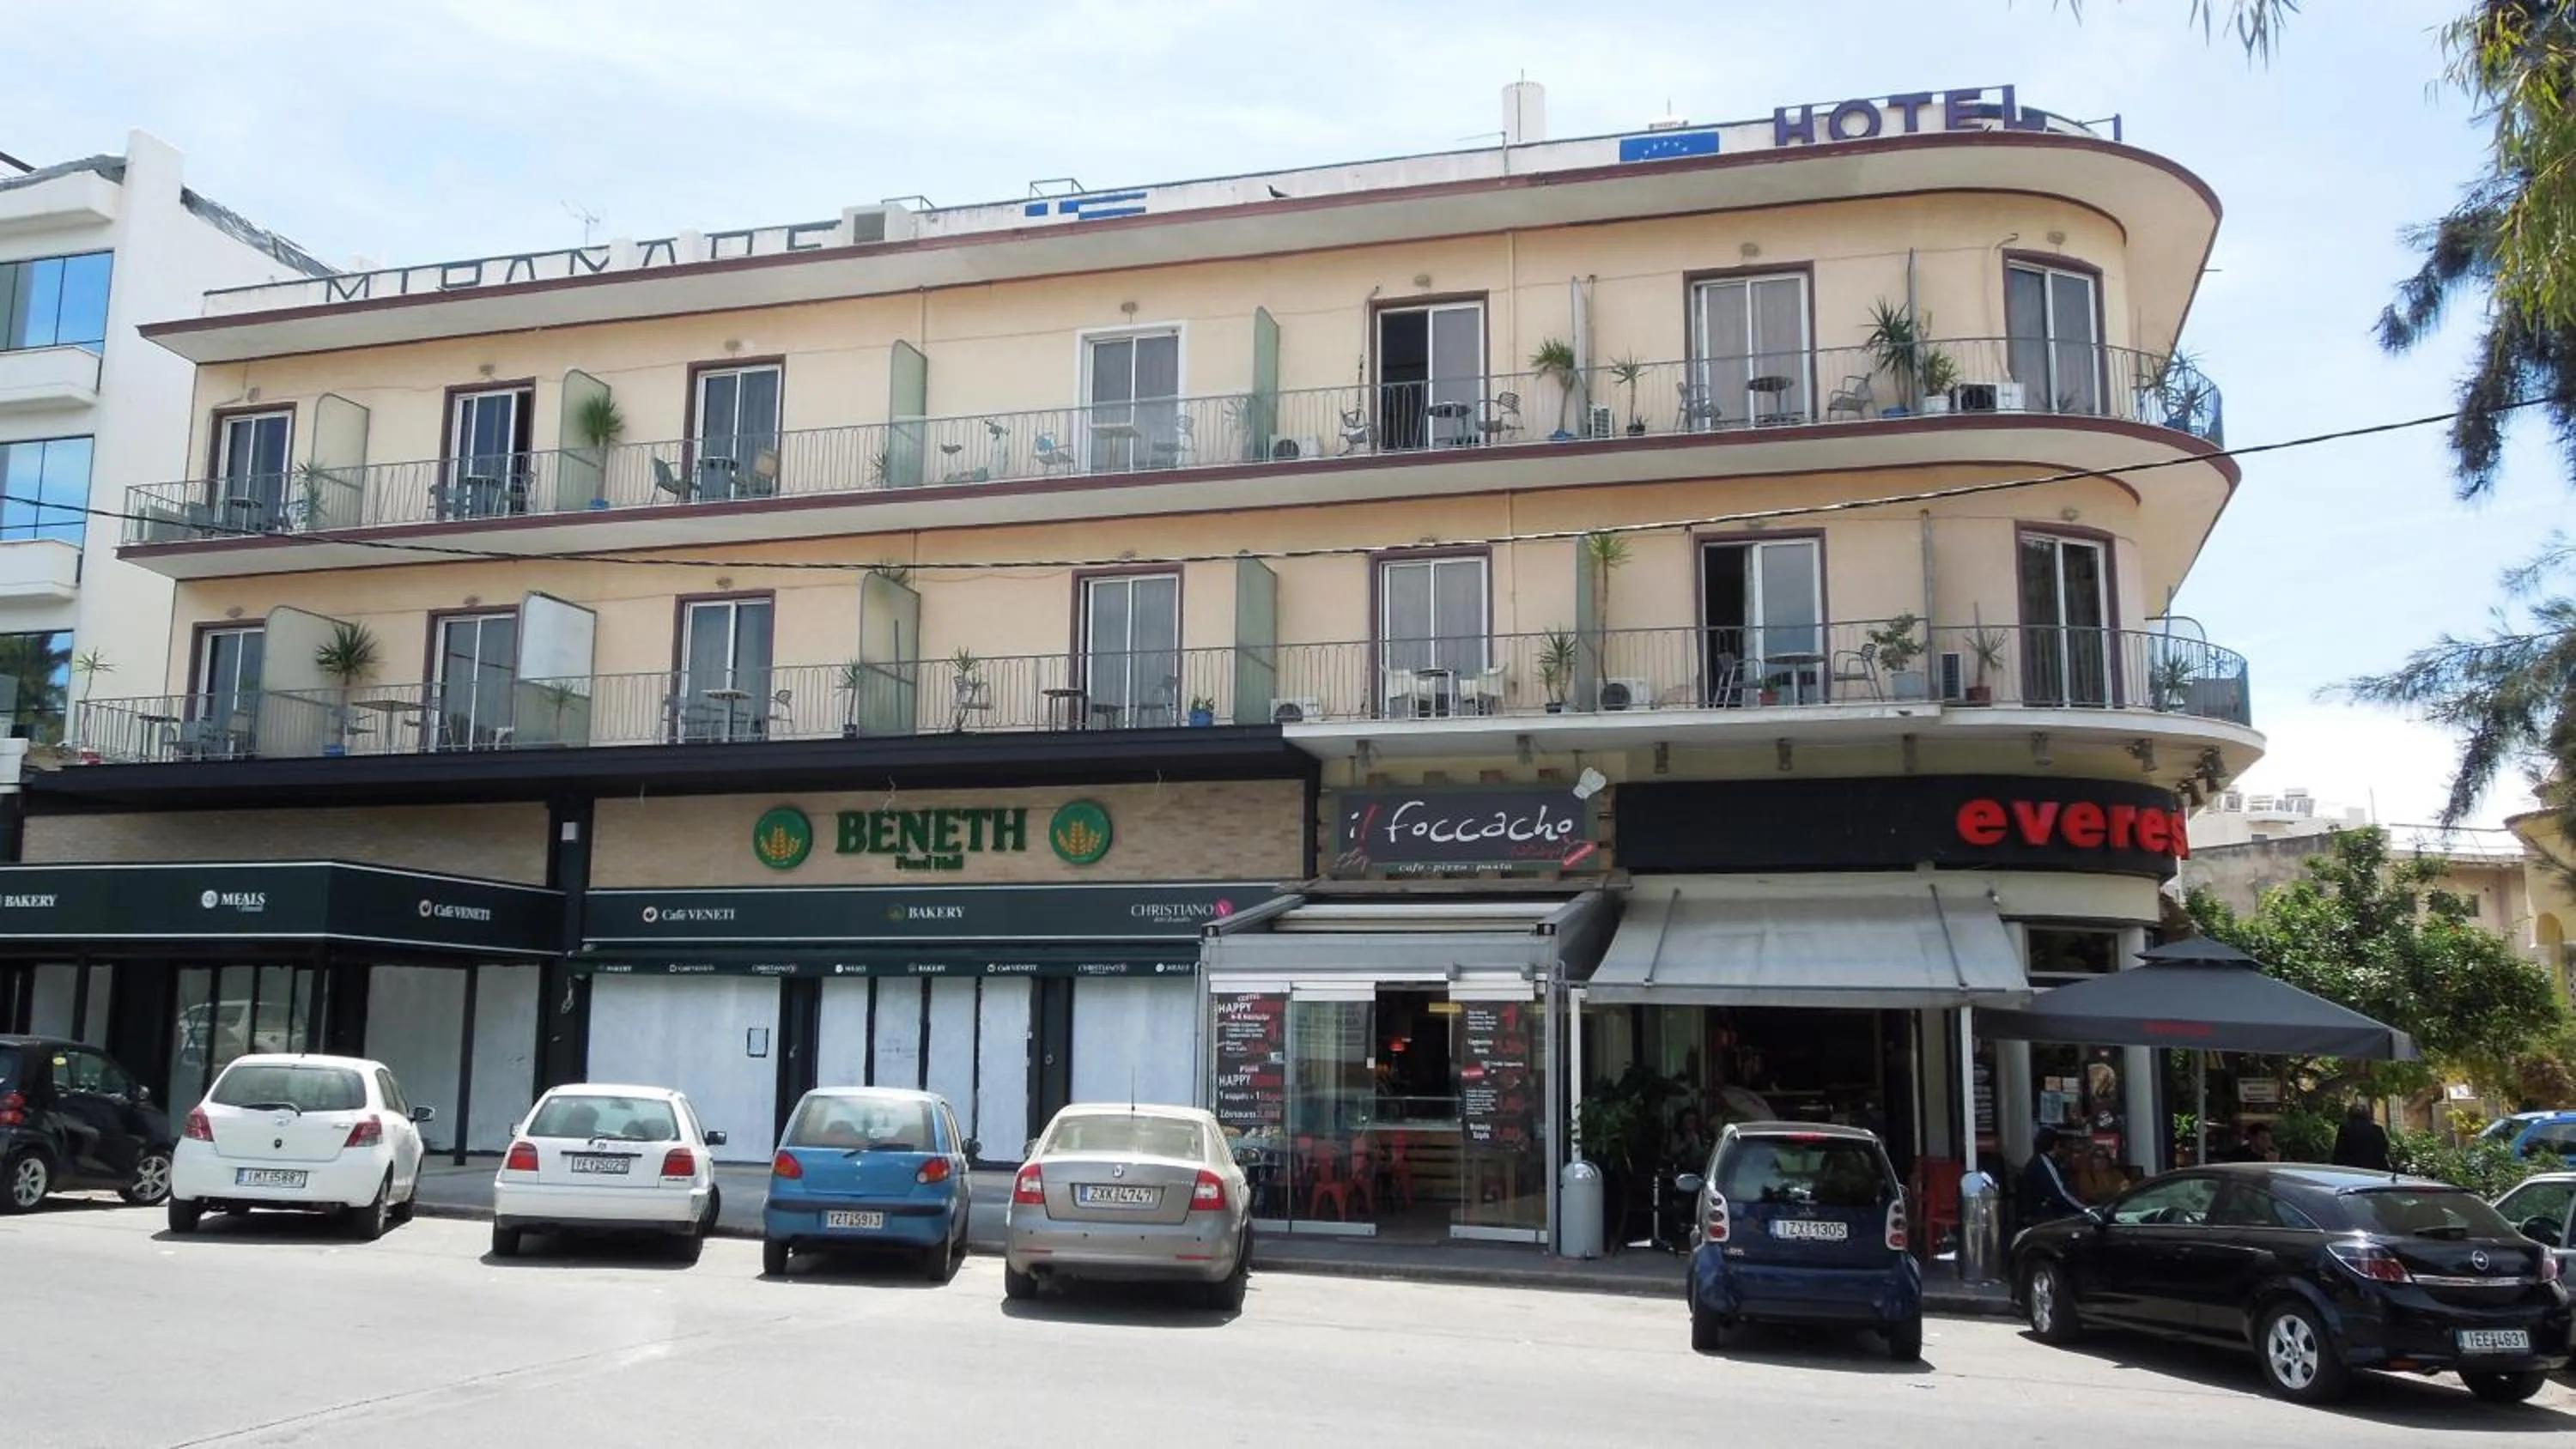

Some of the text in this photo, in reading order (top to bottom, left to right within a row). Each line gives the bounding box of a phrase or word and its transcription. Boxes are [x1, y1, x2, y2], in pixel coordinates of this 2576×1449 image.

[1774, 84, 2047, 147] HOTEL
[1384, 800, 1573, 843] foccacho
[835, 809, 1029, 853] BENETH
[4, 894, 57, 907] BAKERY
[221, 892, 266, 906] MEALS
[908, 906, 965, 919] BAKERY
[1130, 902, 1215, 918] CHRISTIANO
[1218, 1002, 1252, 1014] HAPPY
[1218, 1074, 1251, 1088] HAPPY
